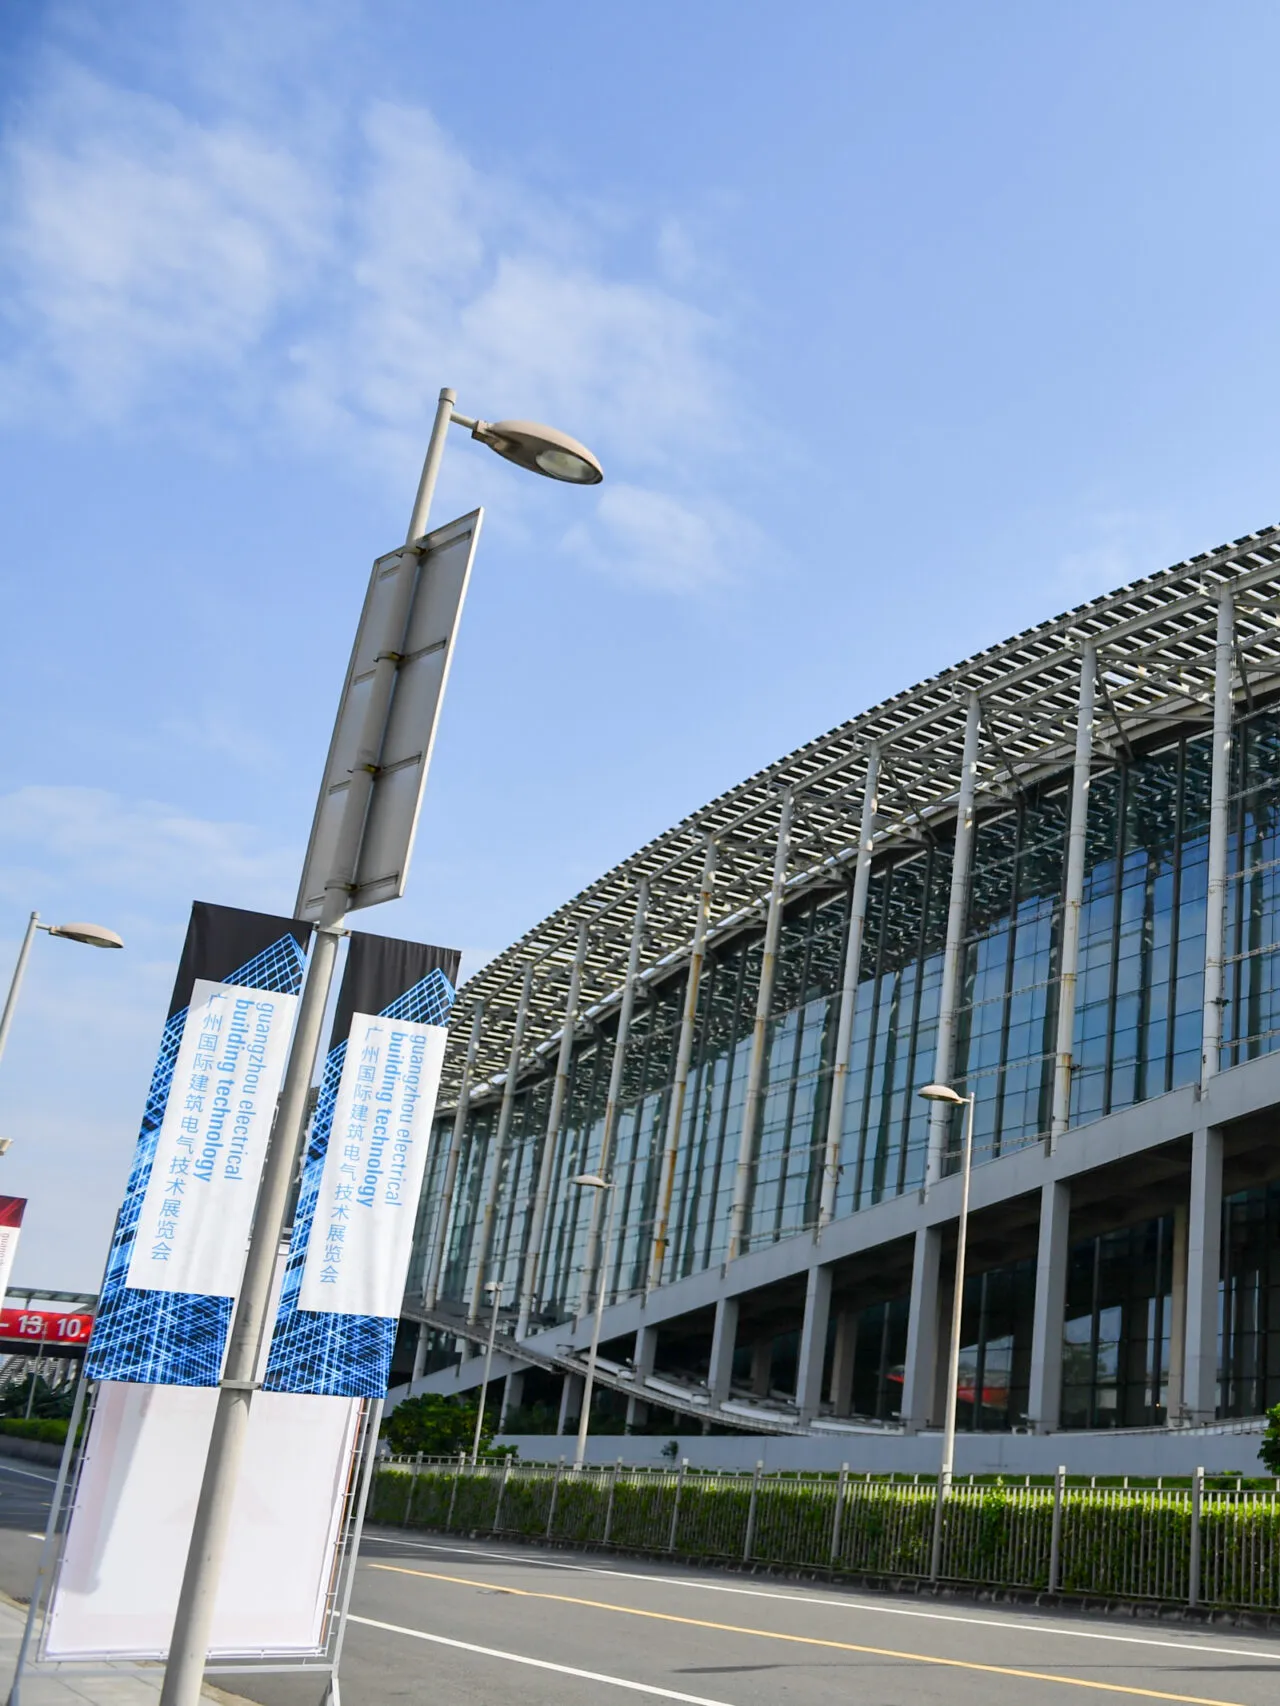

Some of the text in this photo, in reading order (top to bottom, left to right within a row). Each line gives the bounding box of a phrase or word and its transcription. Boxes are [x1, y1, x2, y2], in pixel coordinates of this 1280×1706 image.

[151, 993, 228, 1261] 广州国际建筑电气技术展览会
[192, 998, 255, 1182] building technology
[224, 1002, 274, 1181] guangzhou electrical
[319, 1026, 384, 1285] 广州国际建筑电气技术展览会
[357, 1031, 408, 1208] building technology
[385, 1034, 427, 1207] guangzhou electrical
[57, 1318, 86, 1338] 10.
